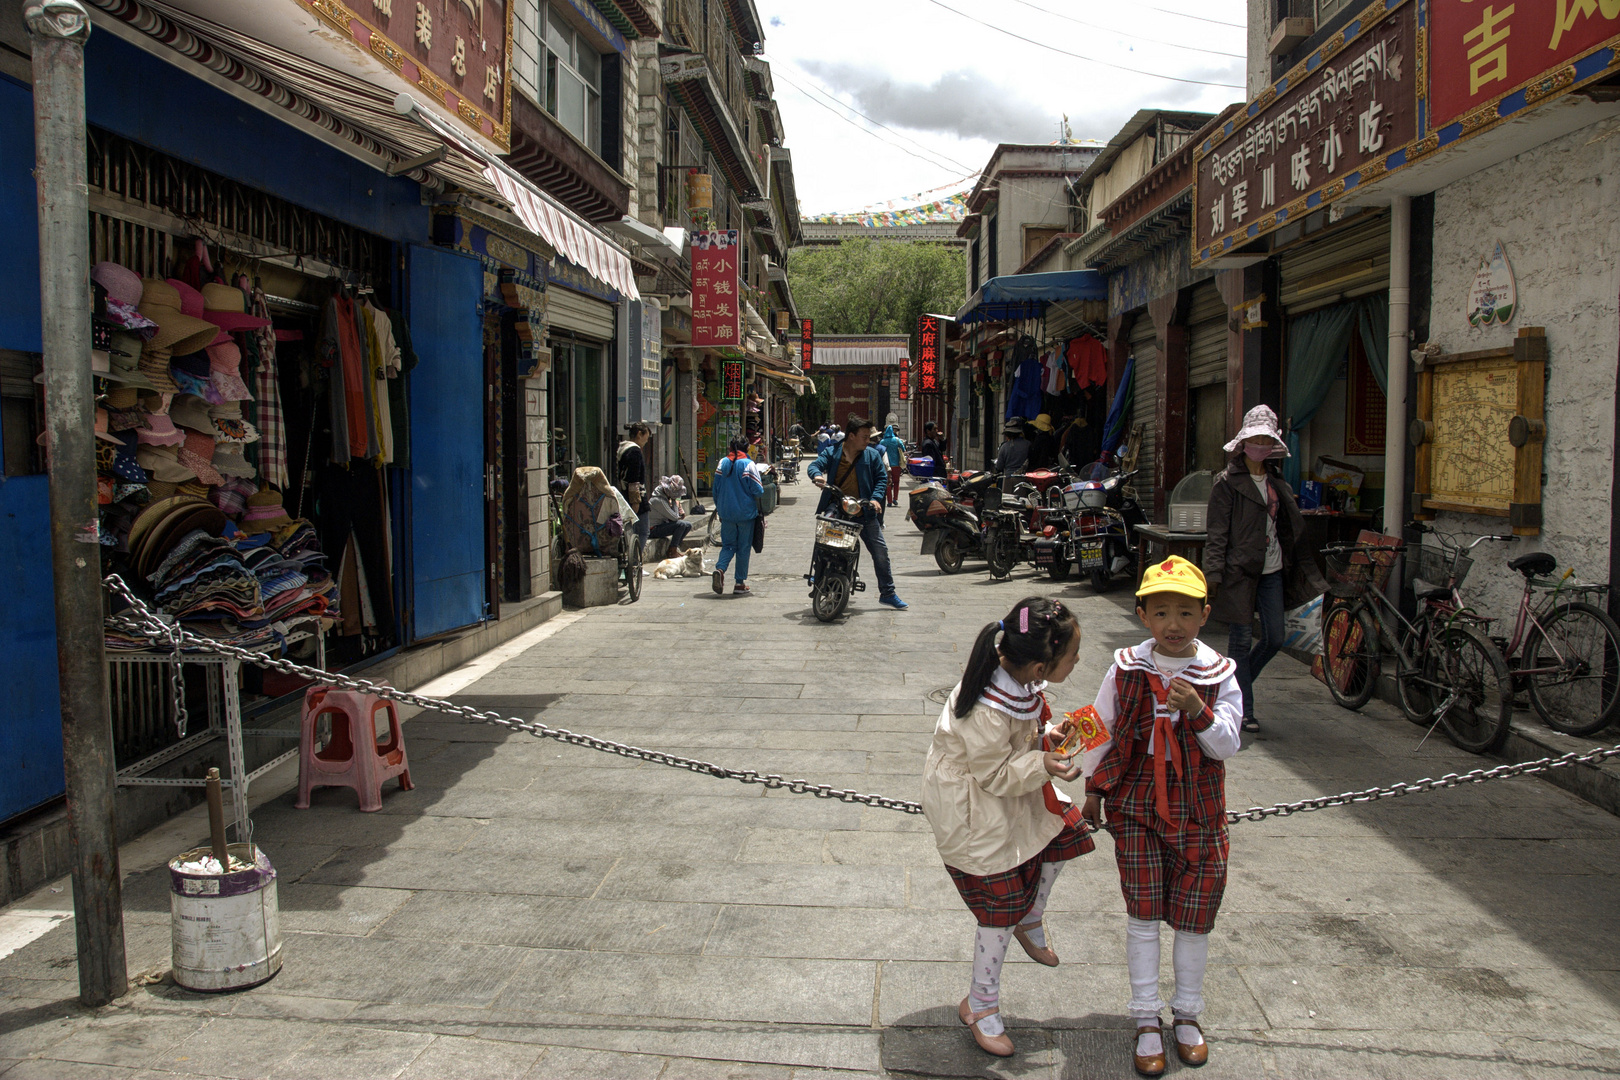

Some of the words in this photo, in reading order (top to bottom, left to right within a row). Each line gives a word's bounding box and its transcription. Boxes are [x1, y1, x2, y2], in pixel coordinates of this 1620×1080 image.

[1210, 100, 1384, 238] 刘军川味小吃
[712, 258, 734, 340] 小钱发廊
[724, 362, 742, 399] 烟酒
[921, 316, 937, 390] 天府麻辣烫
